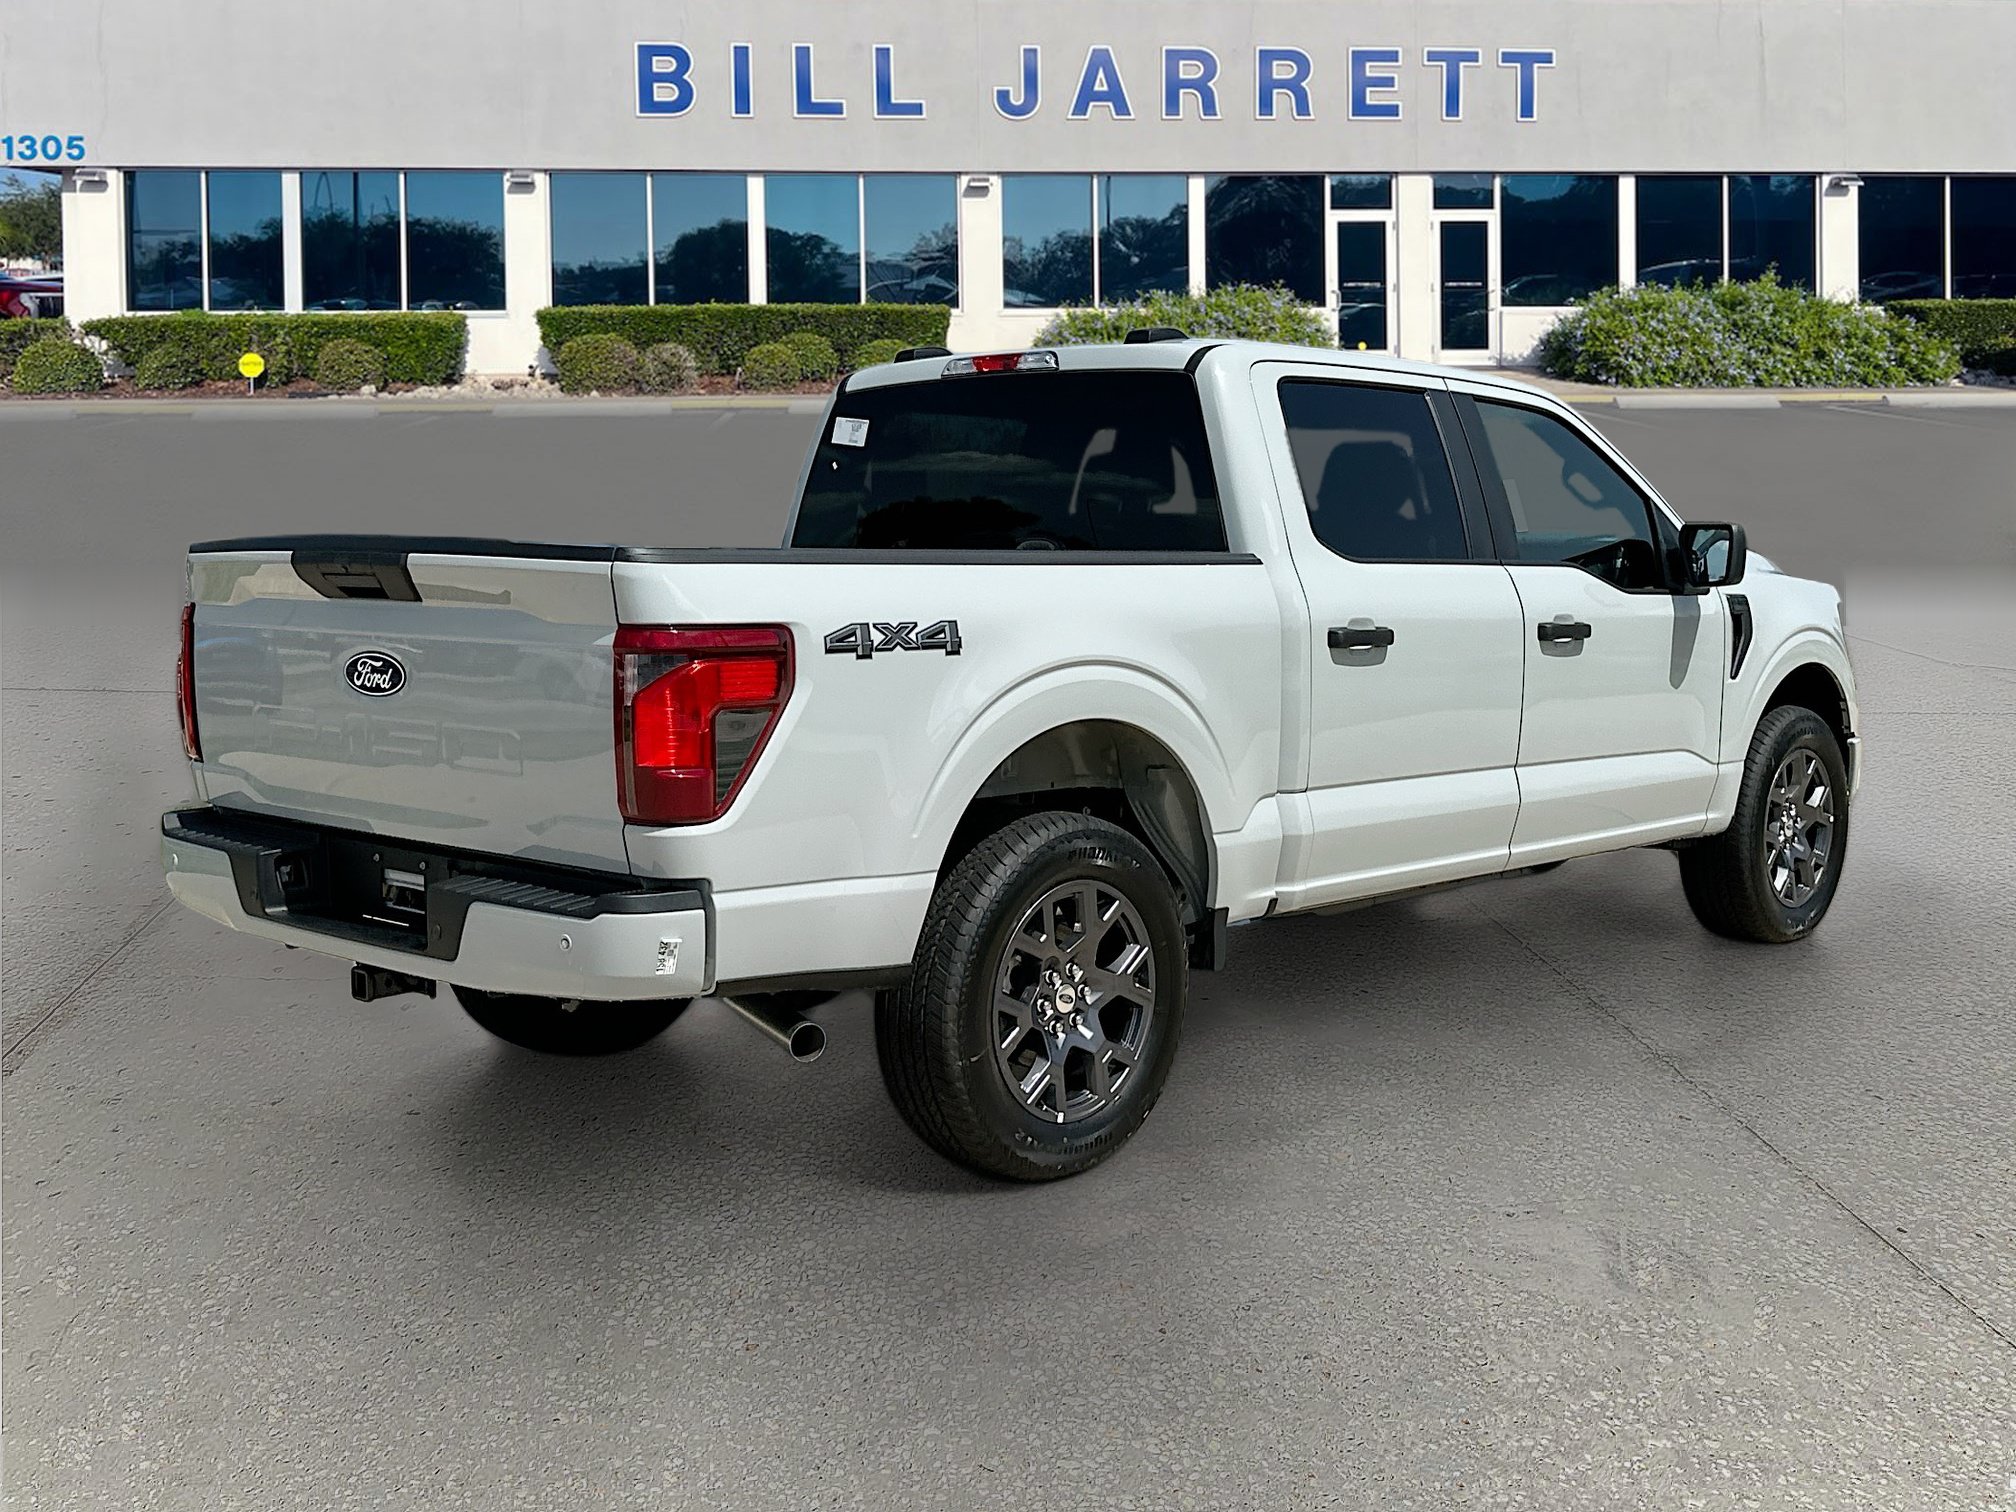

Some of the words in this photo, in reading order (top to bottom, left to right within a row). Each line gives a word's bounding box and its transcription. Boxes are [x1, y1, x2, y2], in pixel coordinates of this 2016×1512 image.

[634, 41, 926, 119] BILL
[993, 45, 1556, 122] JARRETT
[1, 135, 86, 161] 1305
[354, 658, 393, 689] Ford
